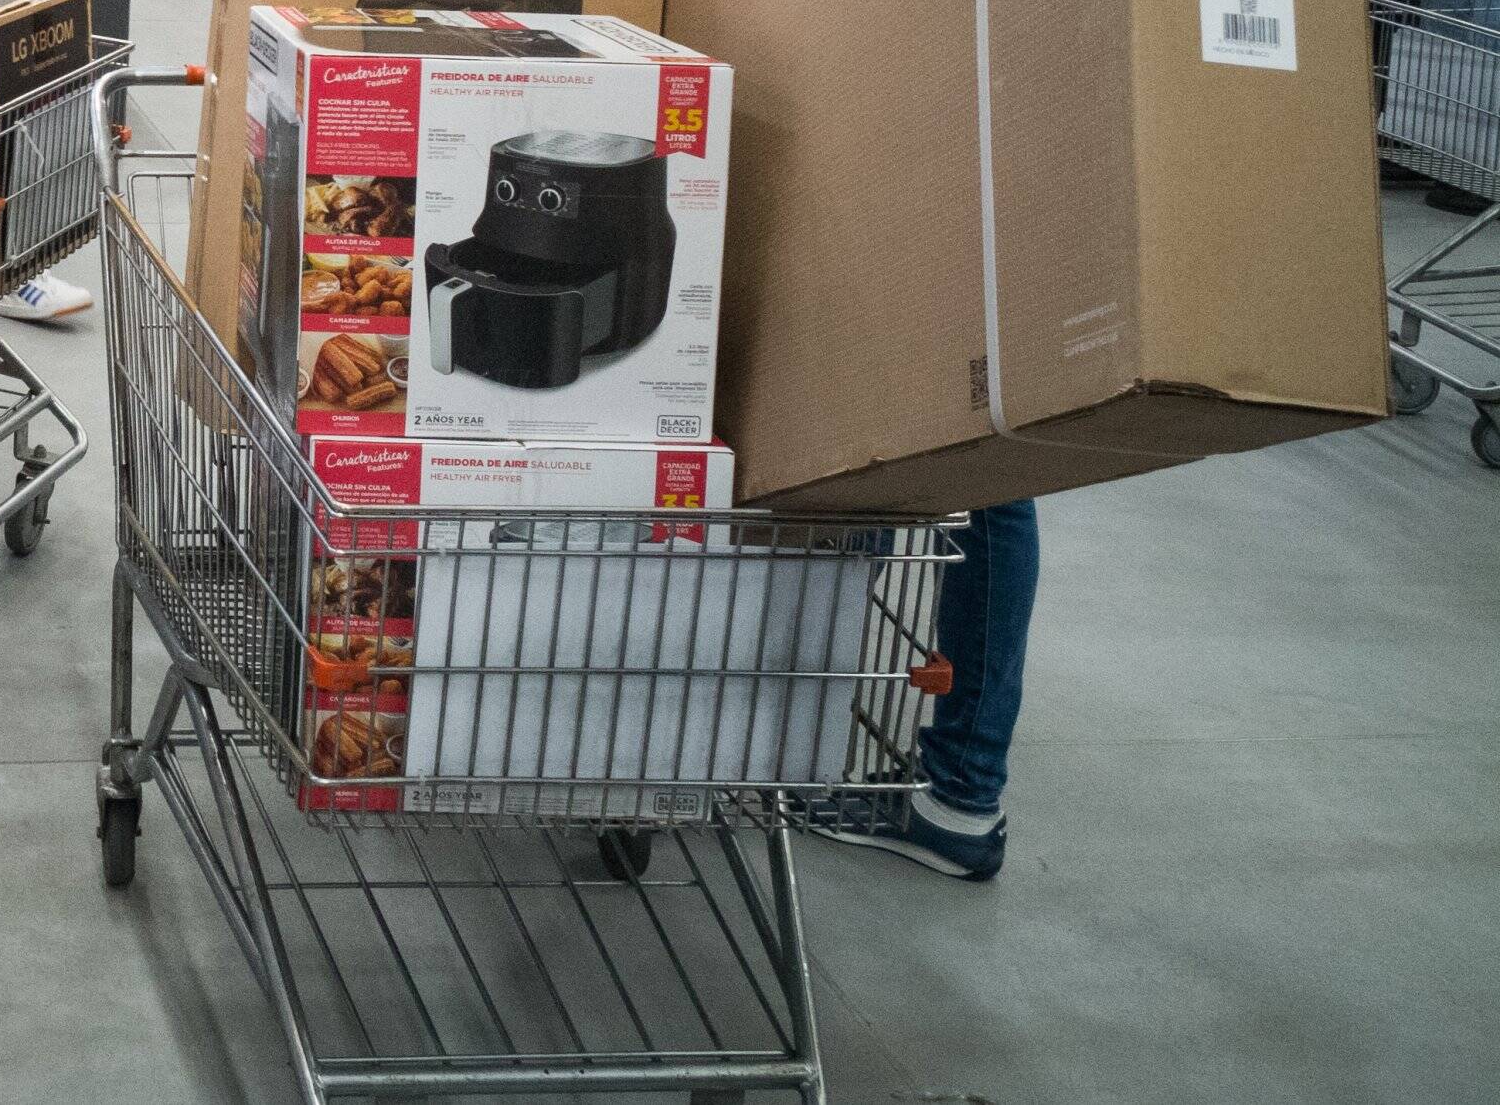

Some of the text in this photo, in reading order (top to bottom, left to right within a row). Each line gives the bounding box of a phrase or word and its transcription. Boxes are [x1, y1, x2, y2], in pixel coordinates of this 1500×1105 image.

[11, 18, 75, 63] LG XBOOM
[431, 72, 594, 85] FREIDORA DE AIRE SALUDABLE
[665, 76, 704, 84] CAPACIDAD
[430, 88, 524, 97] HEALTHY AIR FRYER
[663, 108, 704, 132] 3.5
[665, 133, 697, 143] LITROS
[329, 317, 370, 325] CAMARONES
[414, 413, 484, 425] 2 AÑOS YEAR
[660, 418, 697, 427] BLACK+
[660, 426, 697, 434] DECKER
[431, 457, 592, 471] FREIDORA DE AIRE SALUDABLE
[662, 462, 701, 470] CAPACIDAD
[430, 473, 523, 483] HEALTHY AIR FRYER
[326, 482, 353, 491] OCINAR
[355, 483, 367, 491] SIN
